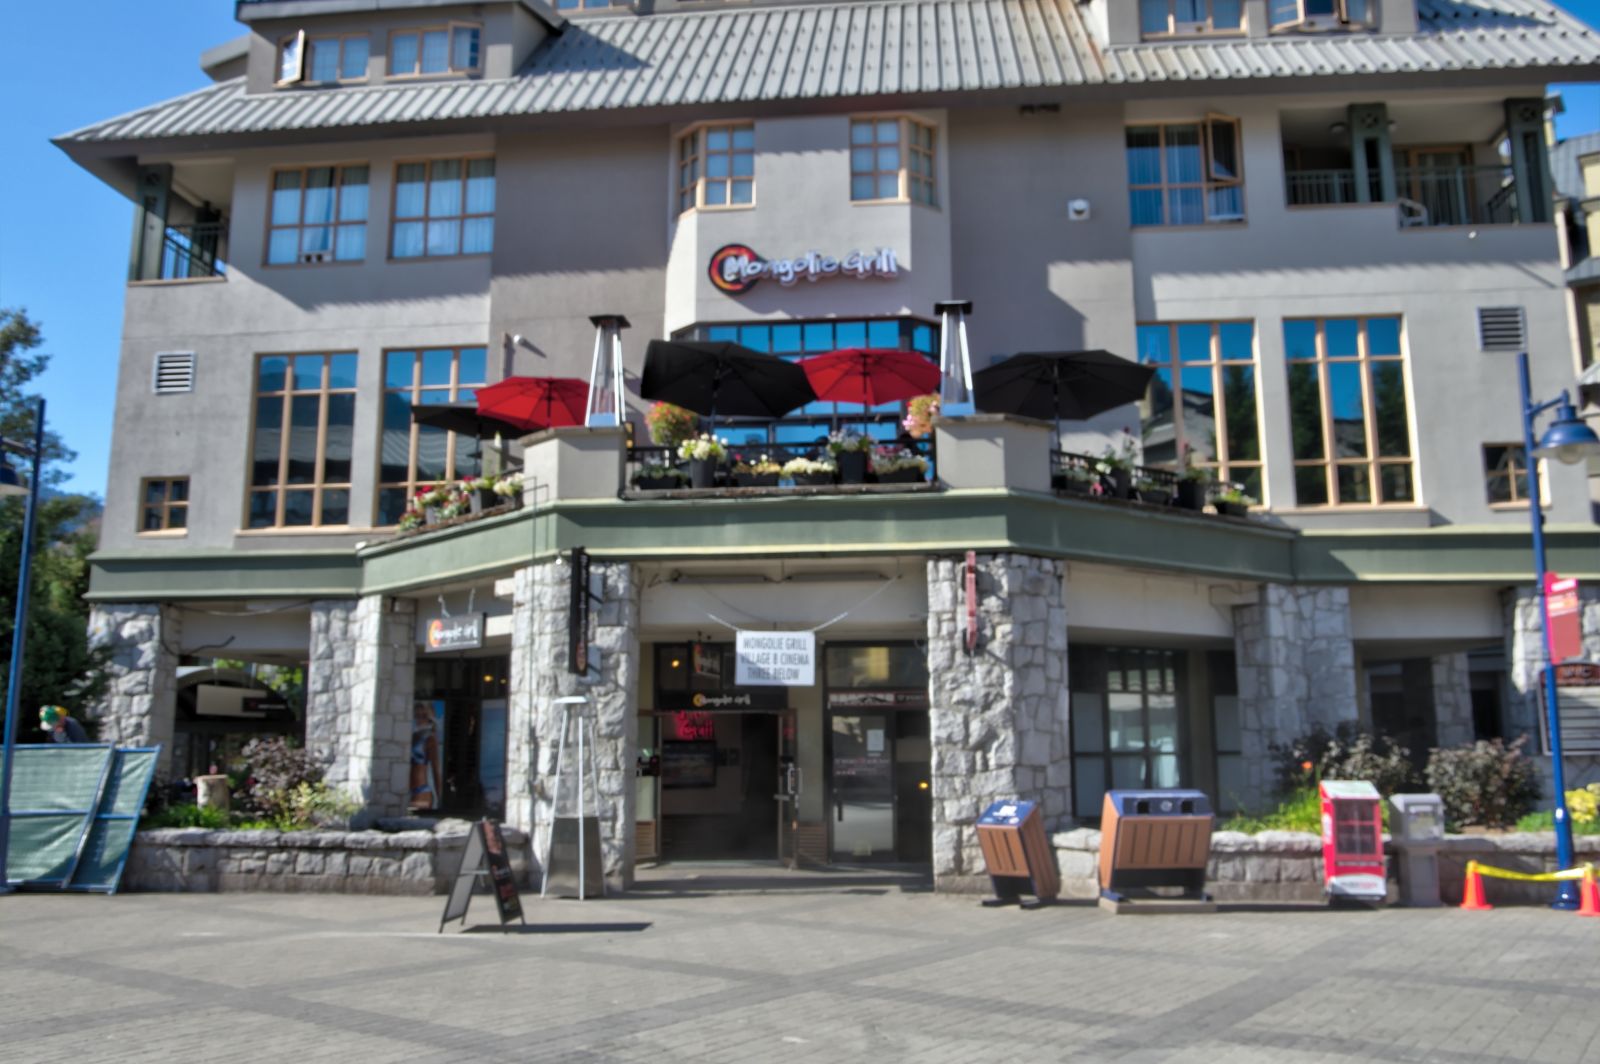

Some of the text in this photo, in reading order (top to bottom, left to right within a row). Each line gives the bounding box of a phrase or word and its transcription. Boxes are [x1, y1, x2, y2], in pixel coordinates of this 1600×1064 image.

[723, 249, 897, 282] Mongolie Grill
[743, 637, 808, 651] MONGOLIE GRILL
[780, 652, 810, 665] CINEMA
